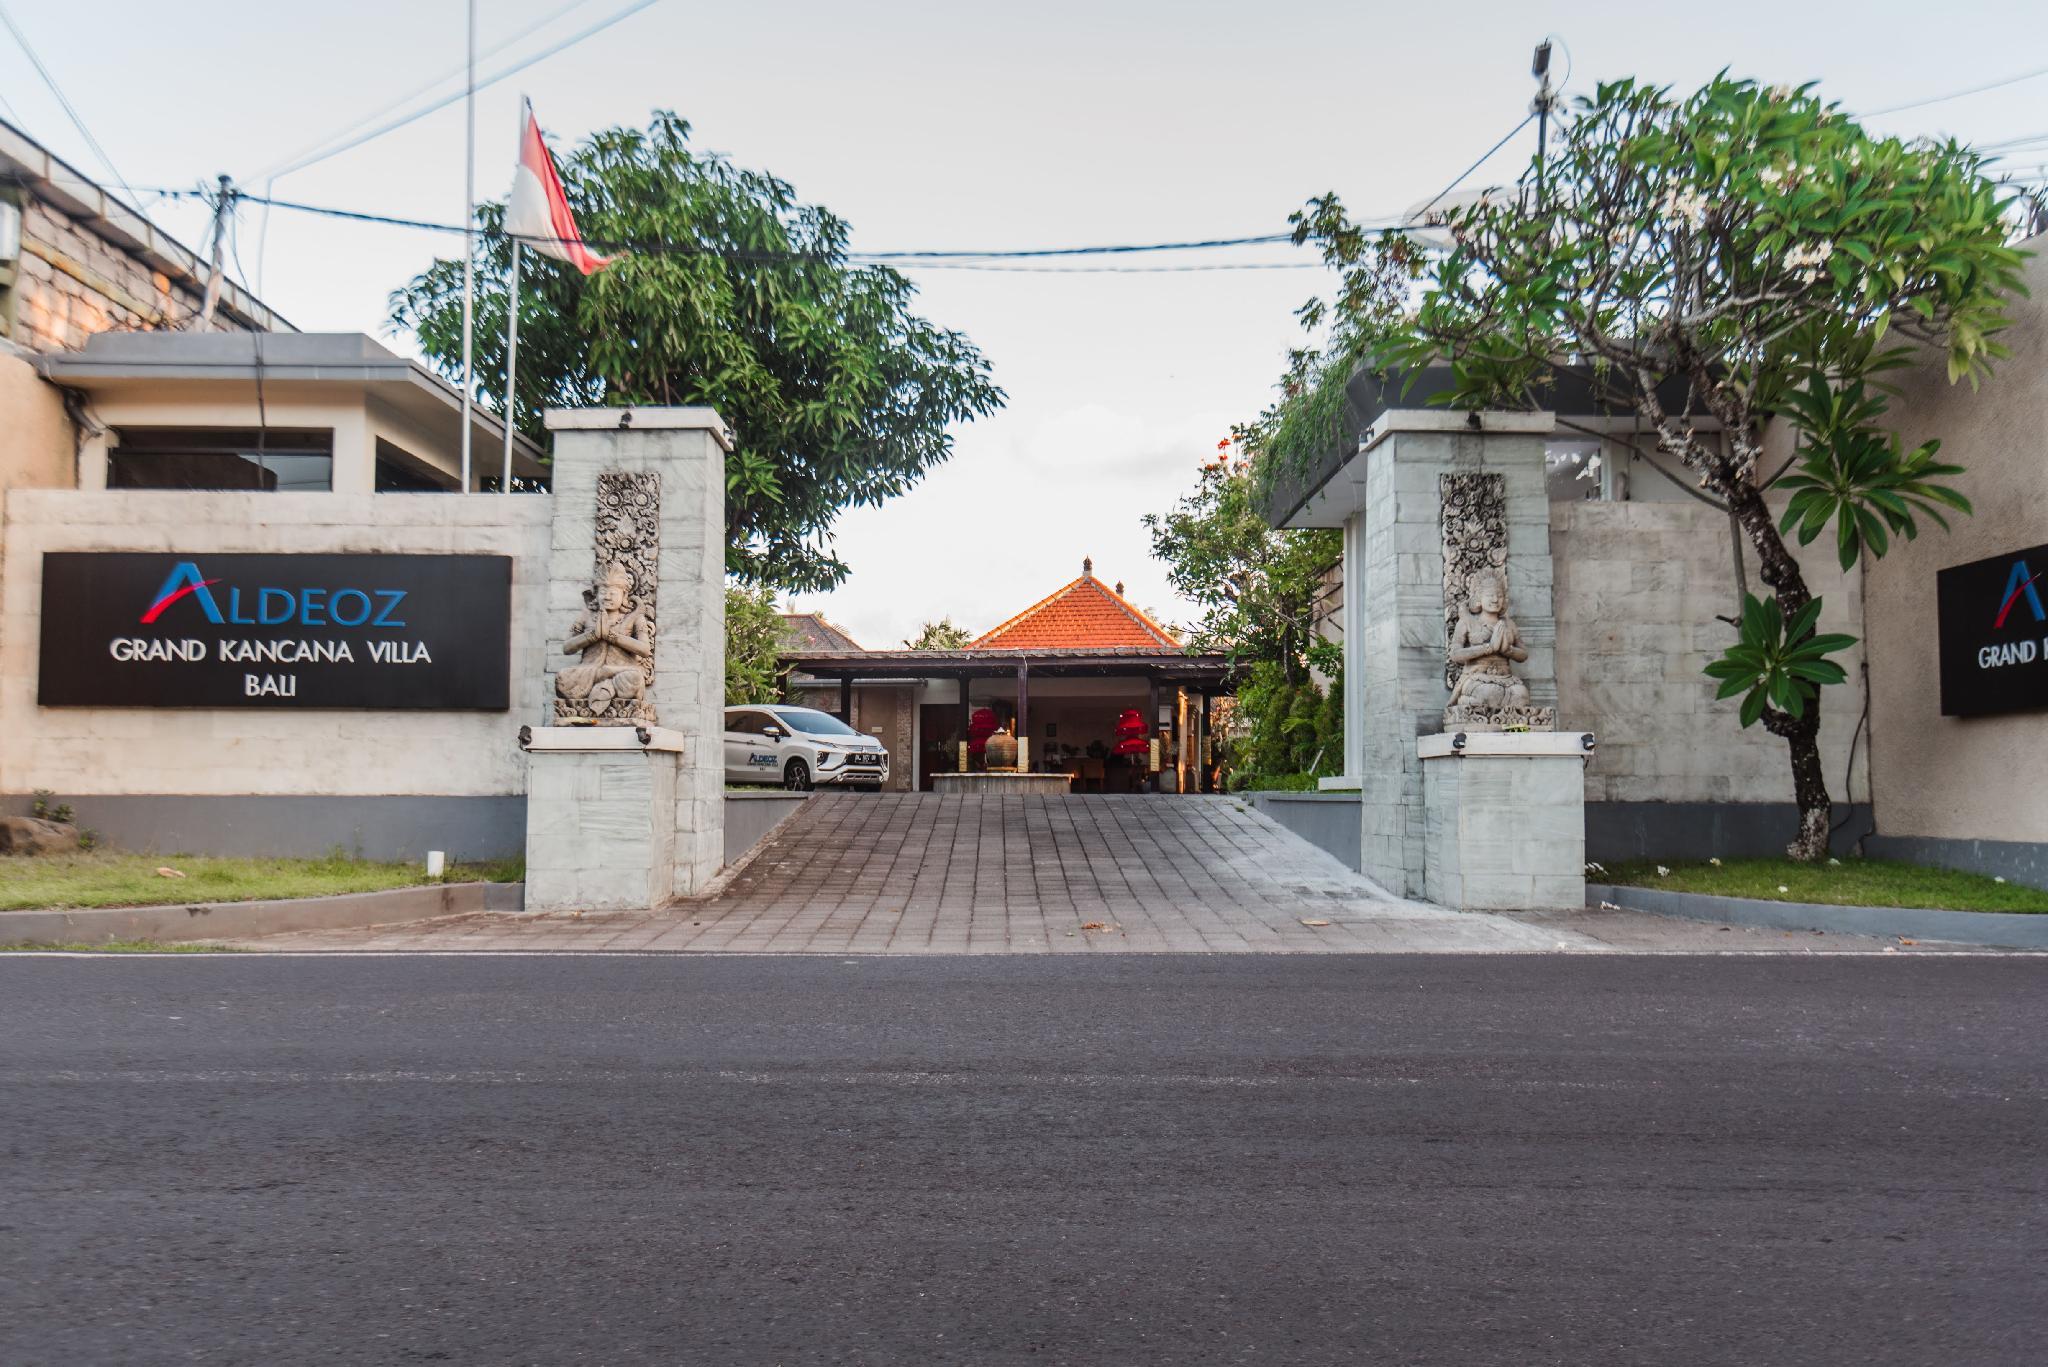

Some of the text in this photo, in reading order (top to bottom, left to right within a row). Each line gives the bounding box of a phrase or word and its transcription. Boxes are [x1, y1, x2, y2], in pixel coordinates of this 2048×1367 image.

[139, 561, 408, 627] ALDEOZ
[109, 638, 432, 664] GRAND KANCANA VILLA
[1978, 640, 2036, 669] GRAND
[245, 674, 296, 697] BALI
